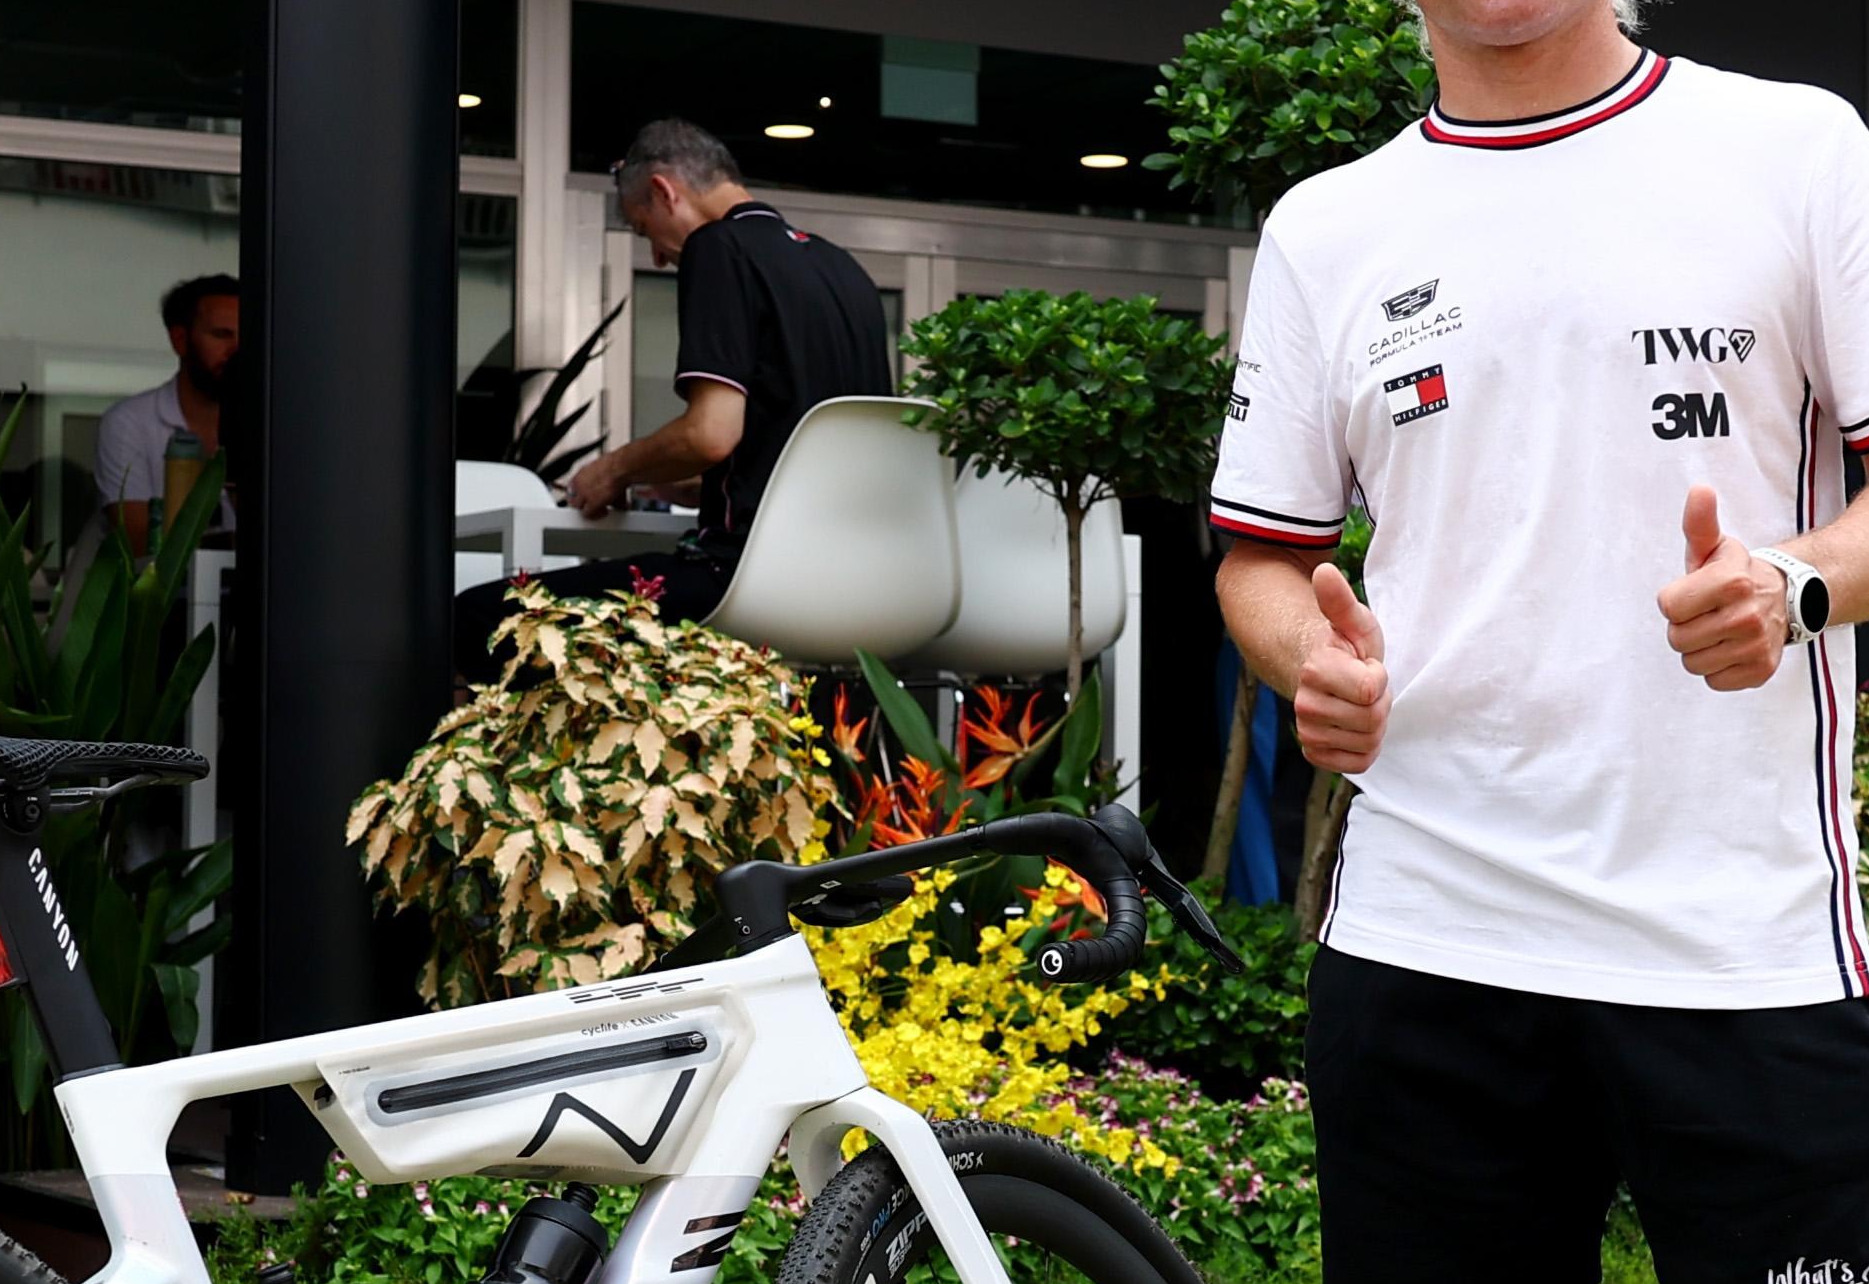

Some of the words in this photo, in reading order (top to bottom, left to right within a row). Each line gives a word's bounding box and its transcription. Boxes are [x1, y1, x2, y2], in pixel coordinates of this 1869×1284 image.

[1368, 306, 1462, 356] CADILLAC
[1369, 340, 1416, 368] FORMULA
[1429, 322, 1463, 340] TEAM
[1631, 327, 1728, 365] TWG
[1386, 367, 1441, 391] TOMMY
[1394, 398, 1447, 423] HILFIGER
[1651, 392, 1730, 441] 3M
[28, 847, 80, 972] CANYON
